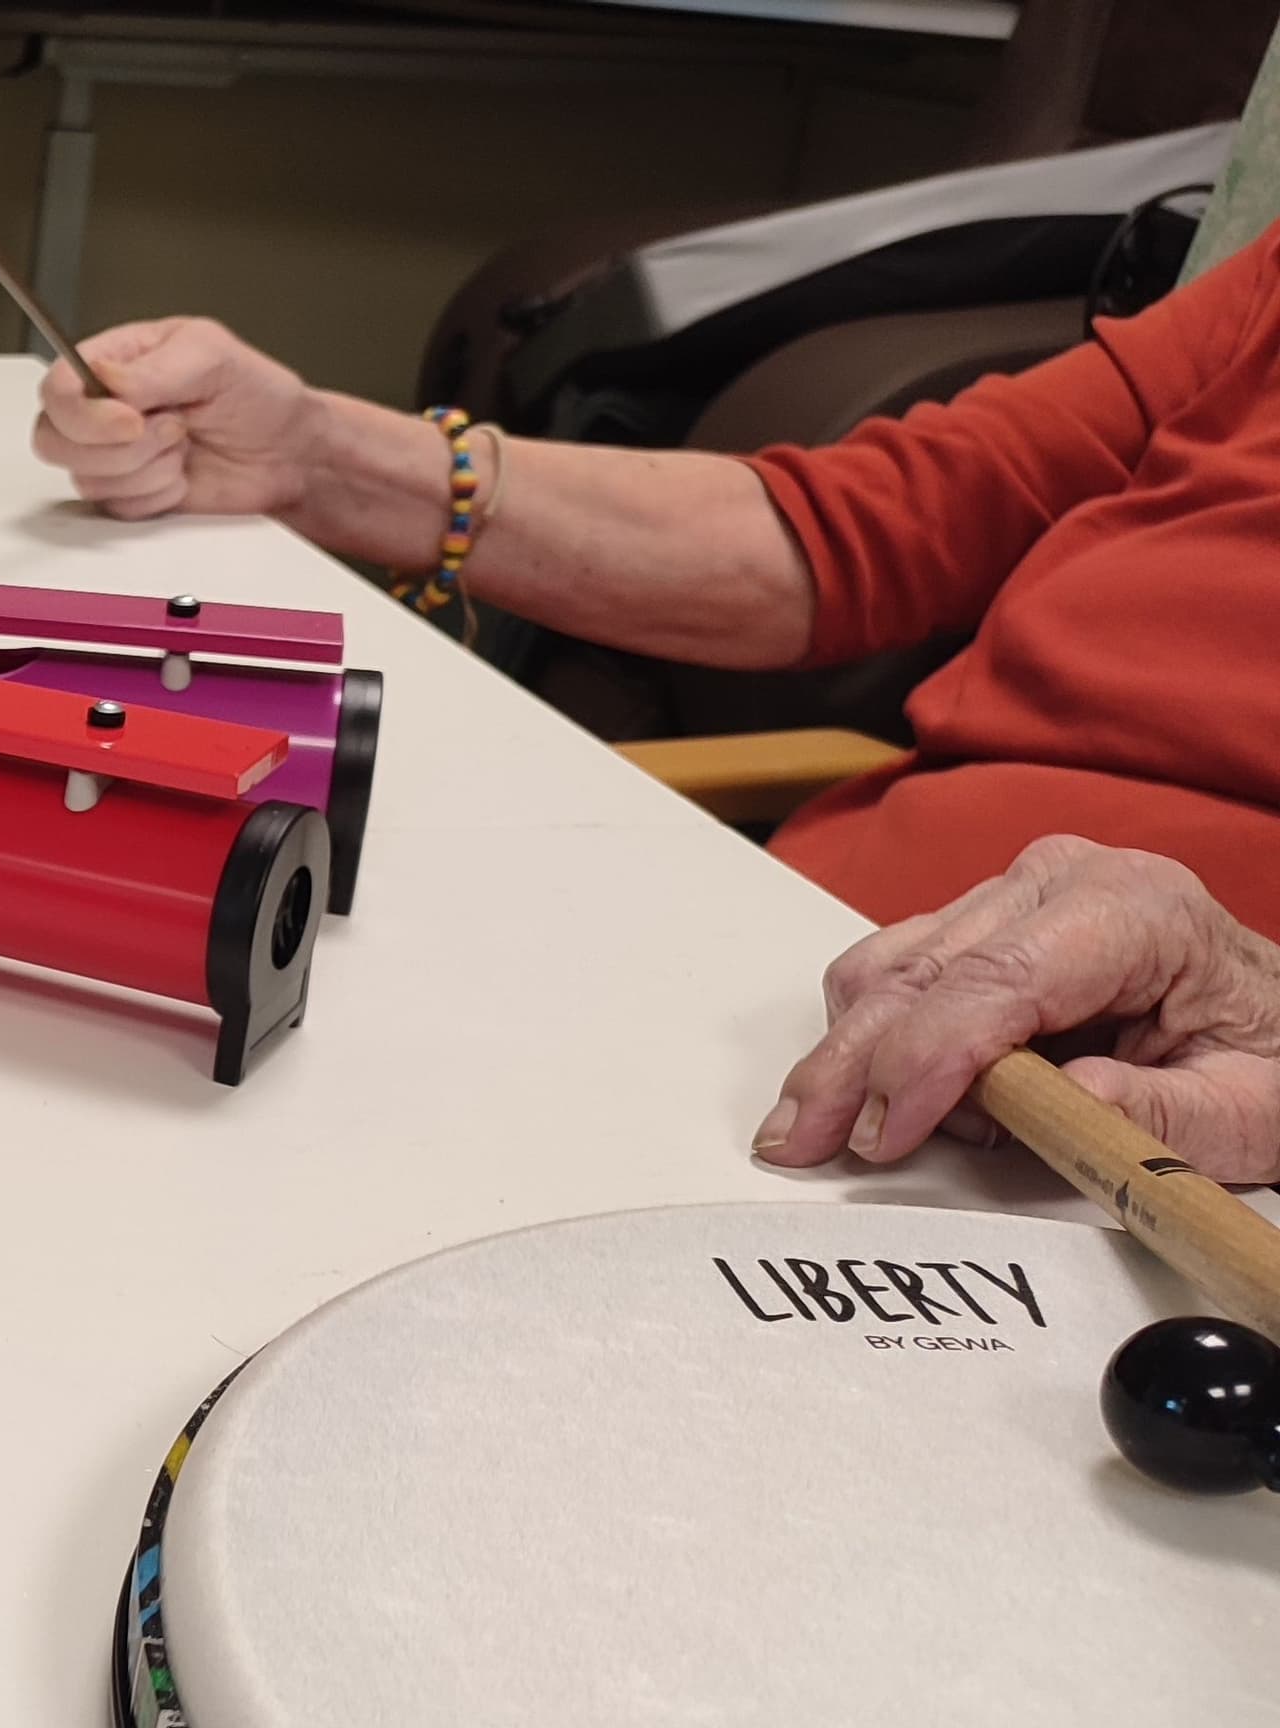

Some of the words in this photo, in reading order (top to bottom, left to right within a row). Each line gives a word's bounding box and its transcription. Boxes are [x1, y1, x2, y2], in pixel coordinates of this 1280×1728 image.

[711, 1256, 1048, 1329] LIBERTY
[863, 1335, 906, 1350] BY
[912, 1335, 1016, 1352] GEWA
